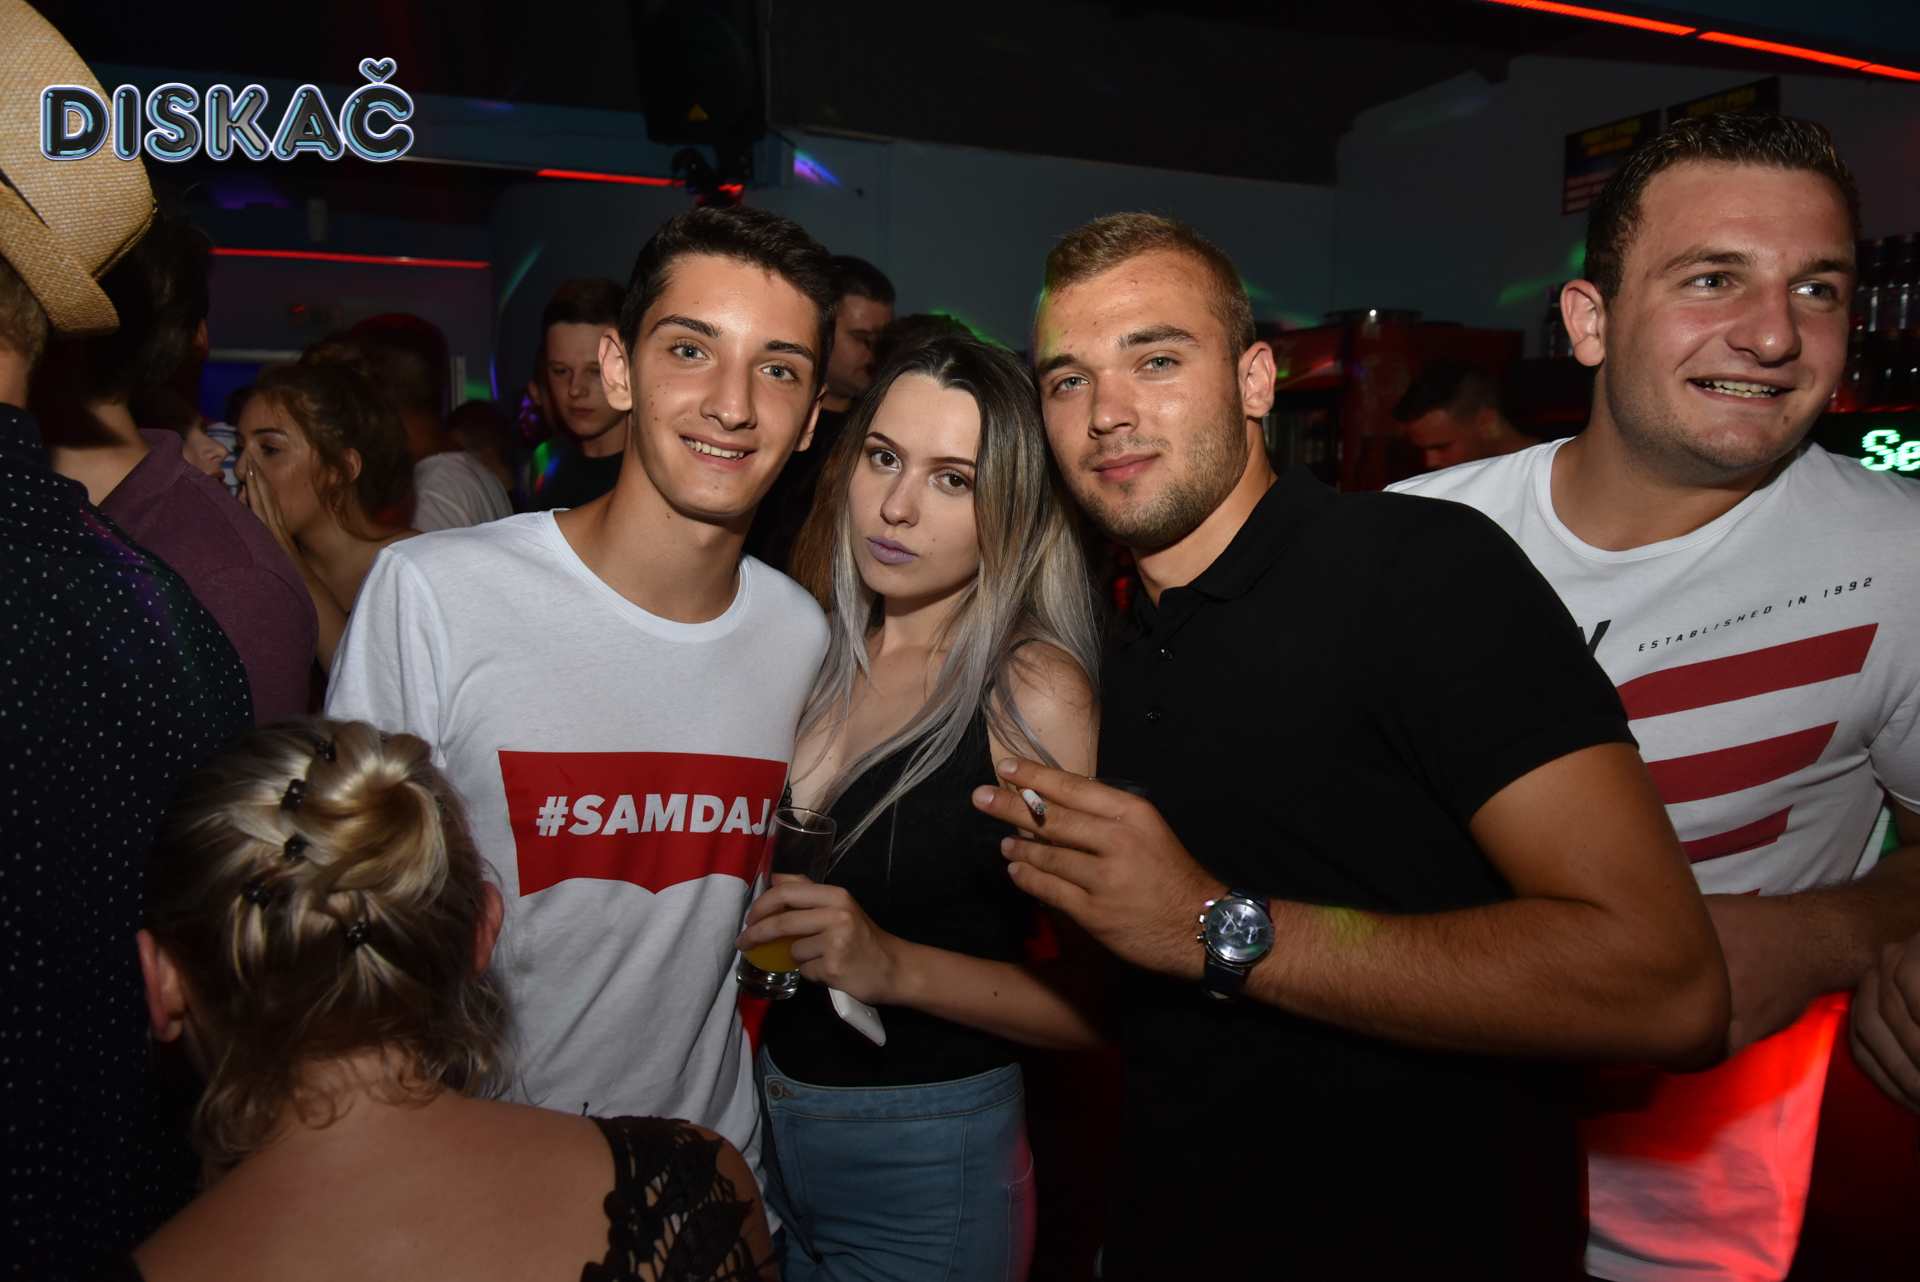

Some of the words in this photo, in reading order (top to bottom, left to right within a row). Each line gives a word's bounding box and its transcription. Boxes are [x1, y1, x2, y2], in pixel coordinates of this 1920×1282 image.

[1638, 605, 1773, 652] ESTABLISHED
[1787, 595, 1807, 608] IN
[1823, 577, 1873, 598] 1992
[535, 793, 772, 837] #SAMDAJ
